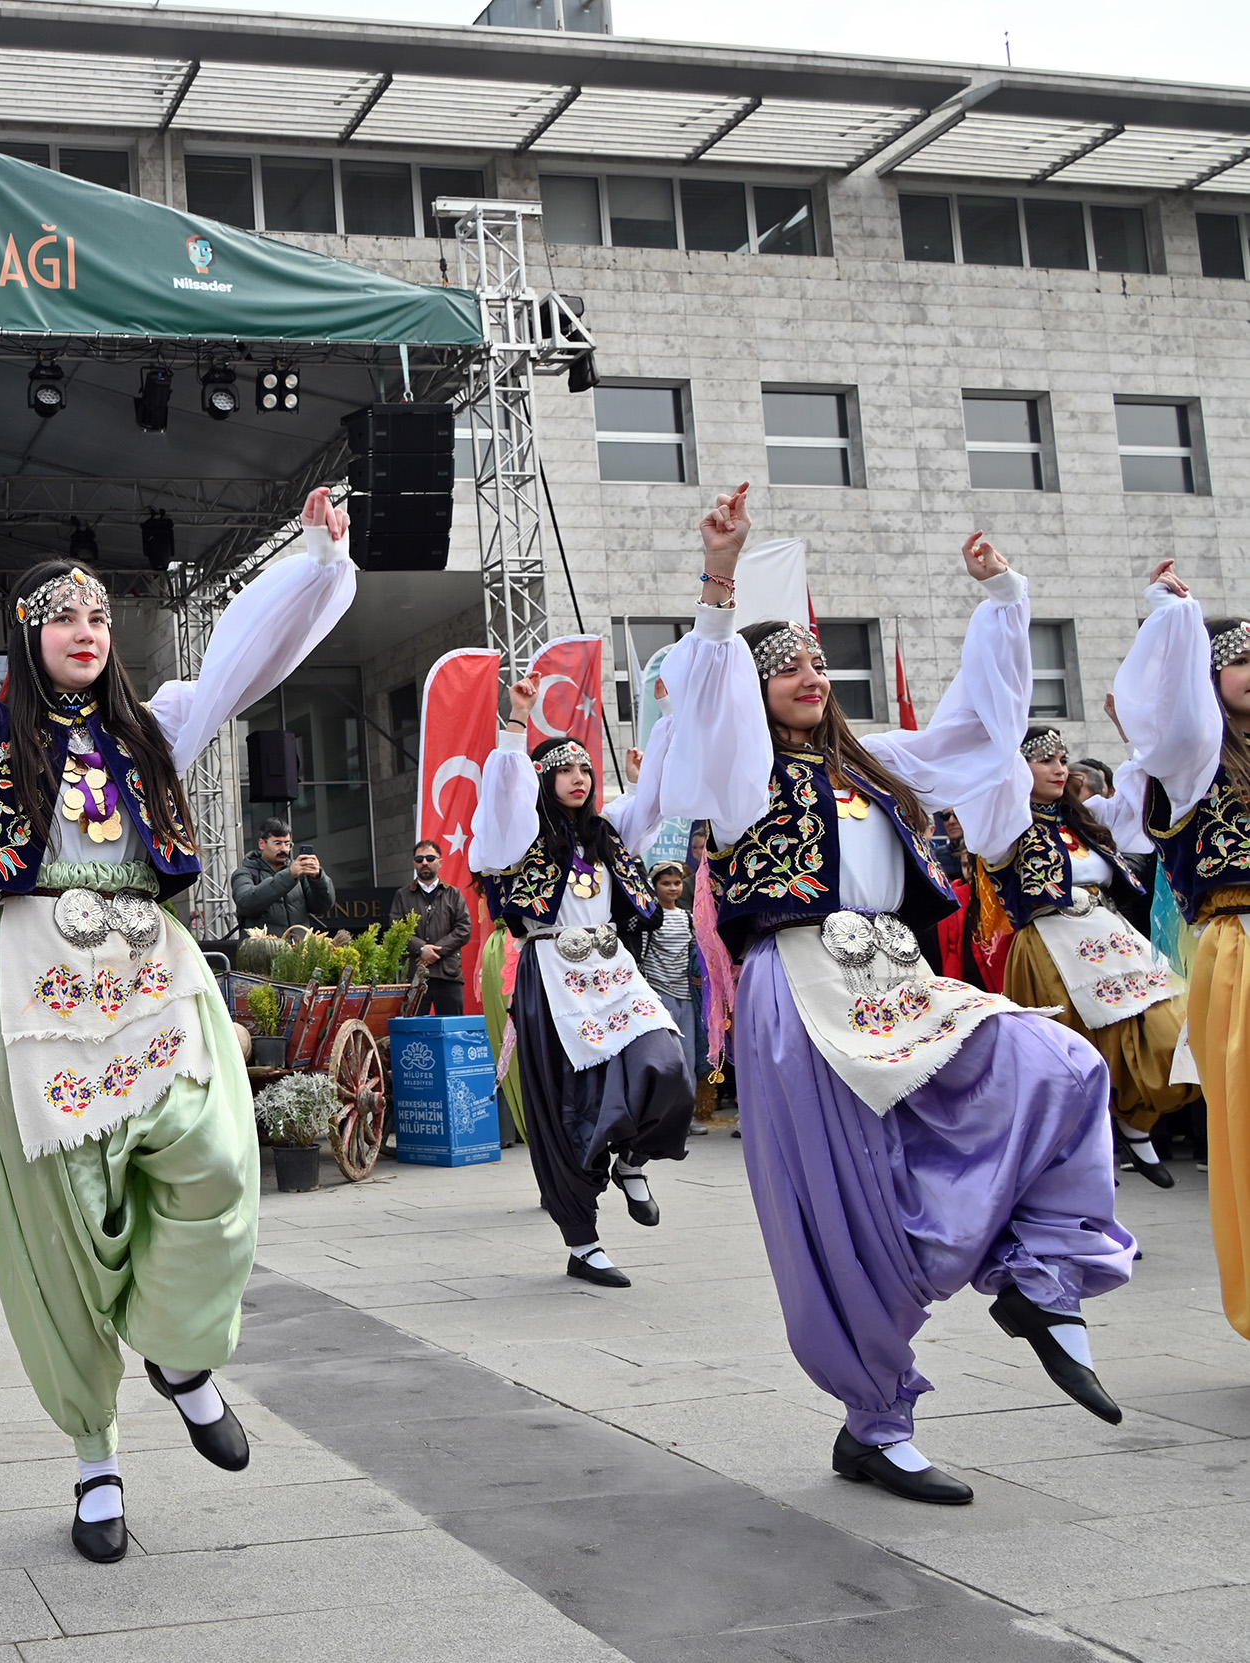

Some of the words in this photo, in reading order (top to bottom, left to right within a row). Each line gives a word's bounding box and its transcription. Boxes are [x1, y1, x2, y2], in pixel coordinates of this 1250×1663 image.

[173, 277, 233, 292] Nilsader
[403, 1070, 434, 1079] NİLÜFER
[397, 1099, 428, 1108] HERKESİN
[428, 1100, 443, 1109] SESİ
[398, 1108, 444, 1122] HEPİMİZİN
[399, 1120, 445, 1136] NİLÜFER'İ
